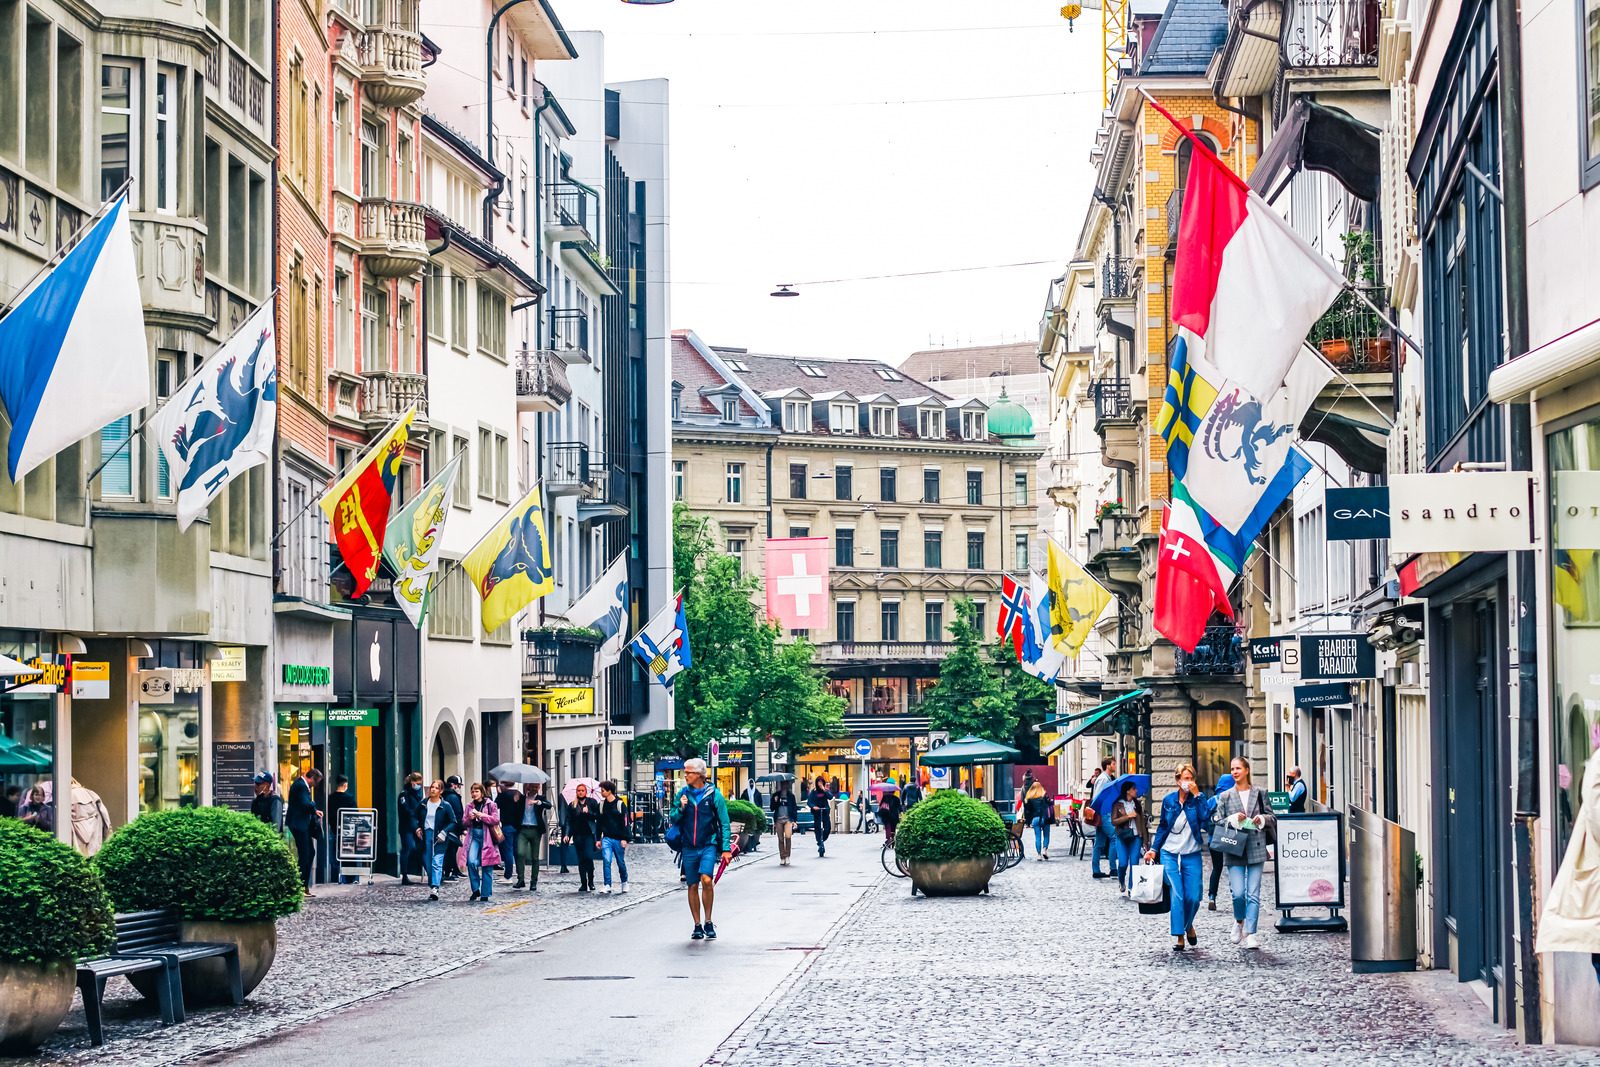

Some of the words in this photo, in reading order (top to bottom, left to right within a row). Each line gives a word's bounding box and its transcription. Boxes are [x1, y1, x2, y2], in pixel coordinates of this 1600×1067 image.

[1333, 508, 1391, 520] GAN
[1400, 503, 1521, 521] sandro
[1324, 638, 1358, 657] BARBER
[1318, 656, 1358, 675] PARADOX
[1300, 695, 1325, 703] GERARD
[1220, 836, 1238, 846] ecco
[1287, 829, 1314, 844] pret
[1281, 844, 1329, 859] beaute
